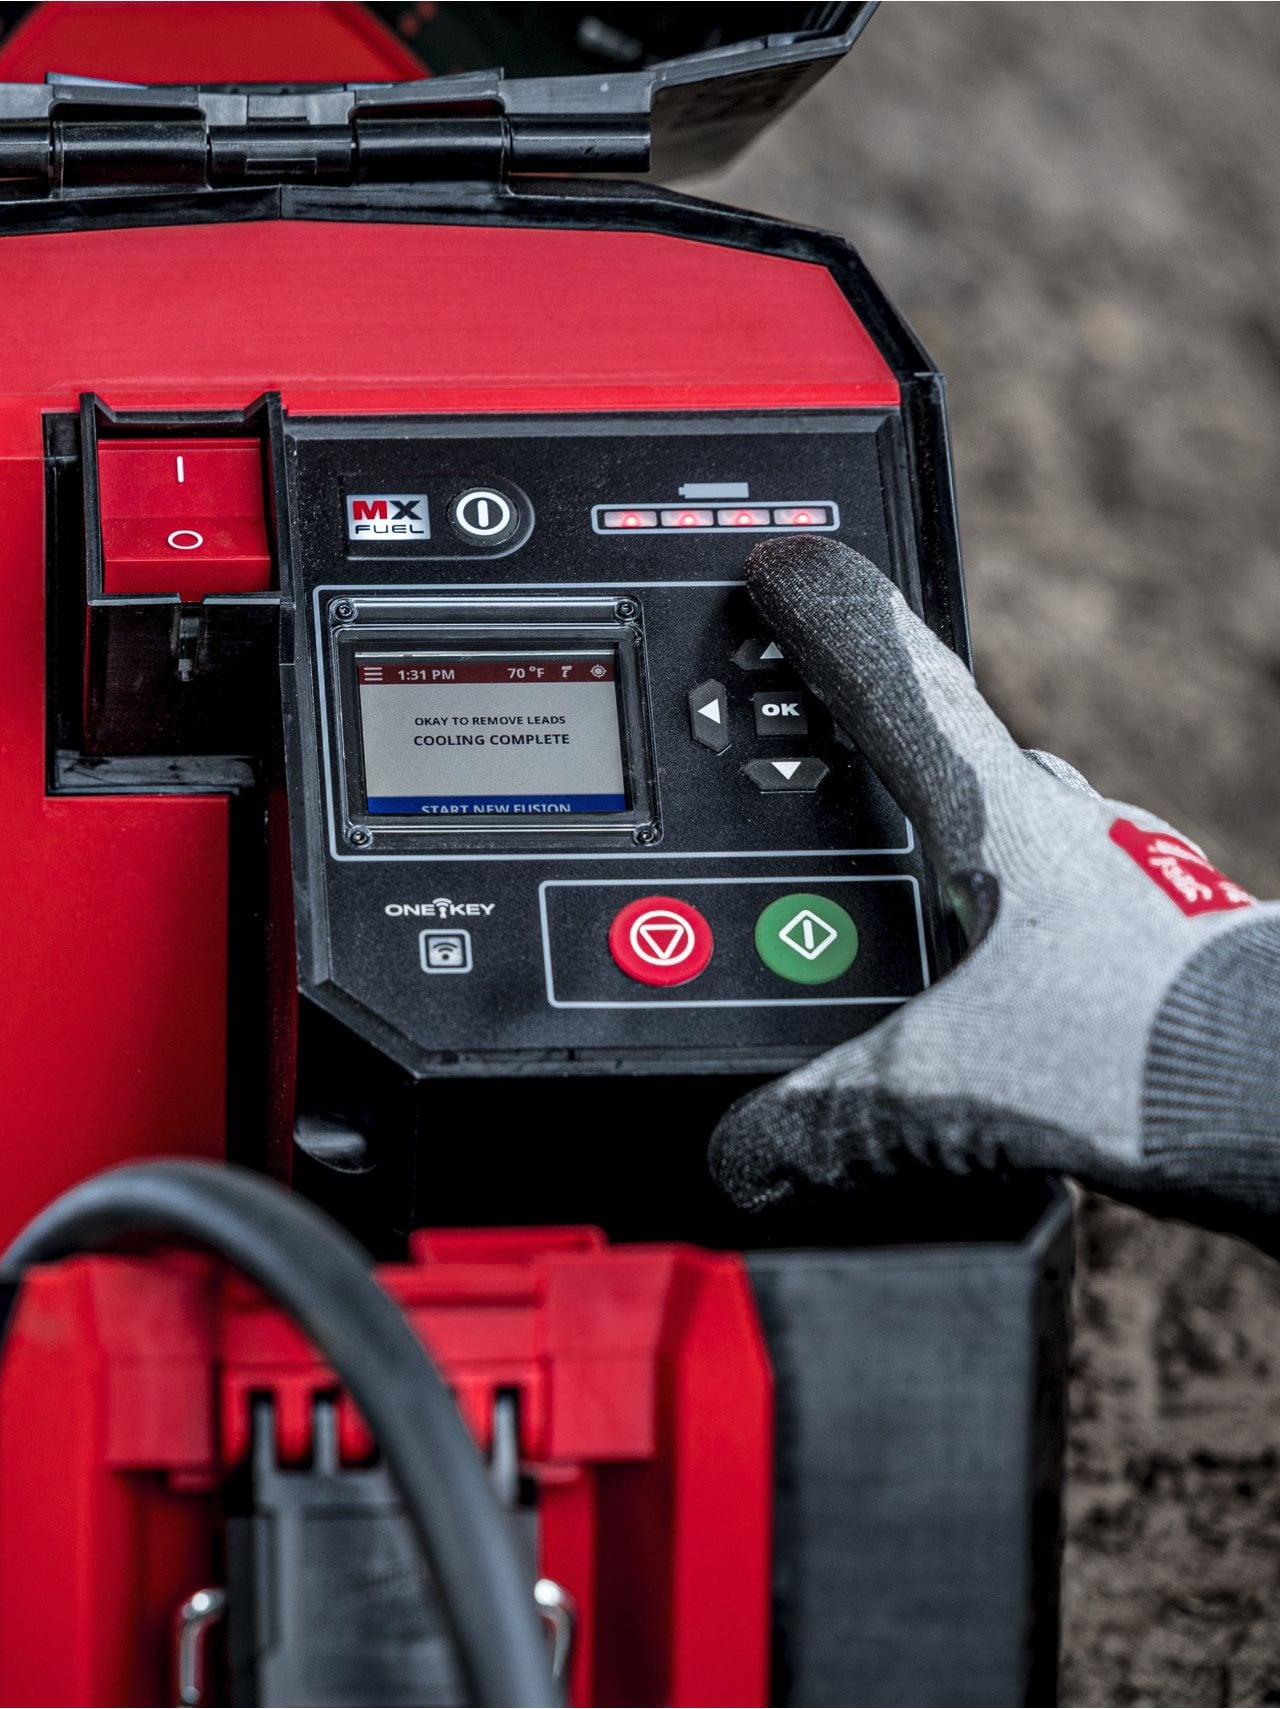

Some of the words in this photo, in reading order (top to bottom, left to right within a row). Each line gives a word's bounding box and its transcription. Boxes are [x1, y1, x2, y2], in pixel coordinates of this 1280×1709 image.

[352, 500, 422, 520] MX
[355, 524, 424, 535] FUEL
[398, 669, 427, 681] 1:31
[432, 669, 455, 680] PM
[507, 667, 526, 679] 70
[761, 703, 800, 717] OK
[414, 717, 448, 726] OKAY
[452, 717, 469, 726] TO
[472, 716, 524, 726] REMOVE
[527, 715, 566, 725] LEADS
[413, 735, 485, 746] COOLING
[489, 734, 570, 746] COMPLETE
[384, 903, 437, 917] ONE
[449, 903, 496, 916] KEY
